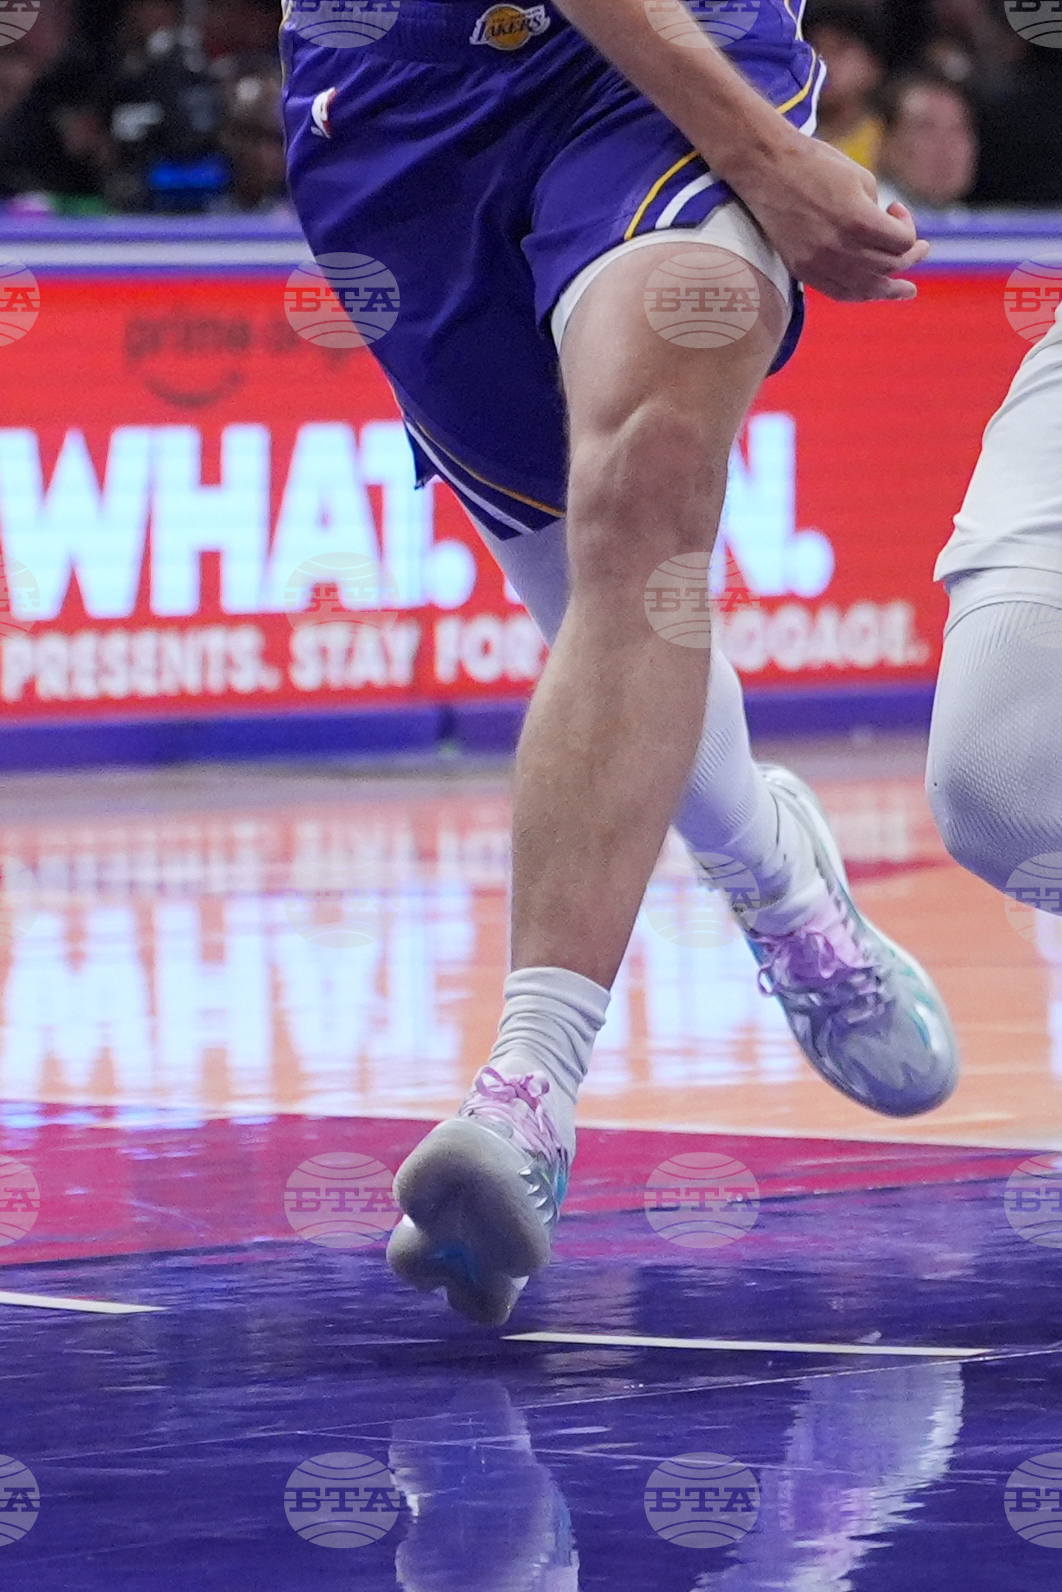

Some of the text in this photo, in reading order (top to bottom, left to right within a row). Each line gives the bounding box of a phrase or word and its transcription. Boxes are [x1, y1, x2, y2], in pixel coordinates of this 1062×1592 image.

[0, 421, 477, 621] WHAT.
[2, 625, 281, 702] PRESENTS.
[290, 617, 424, 691] STAY
